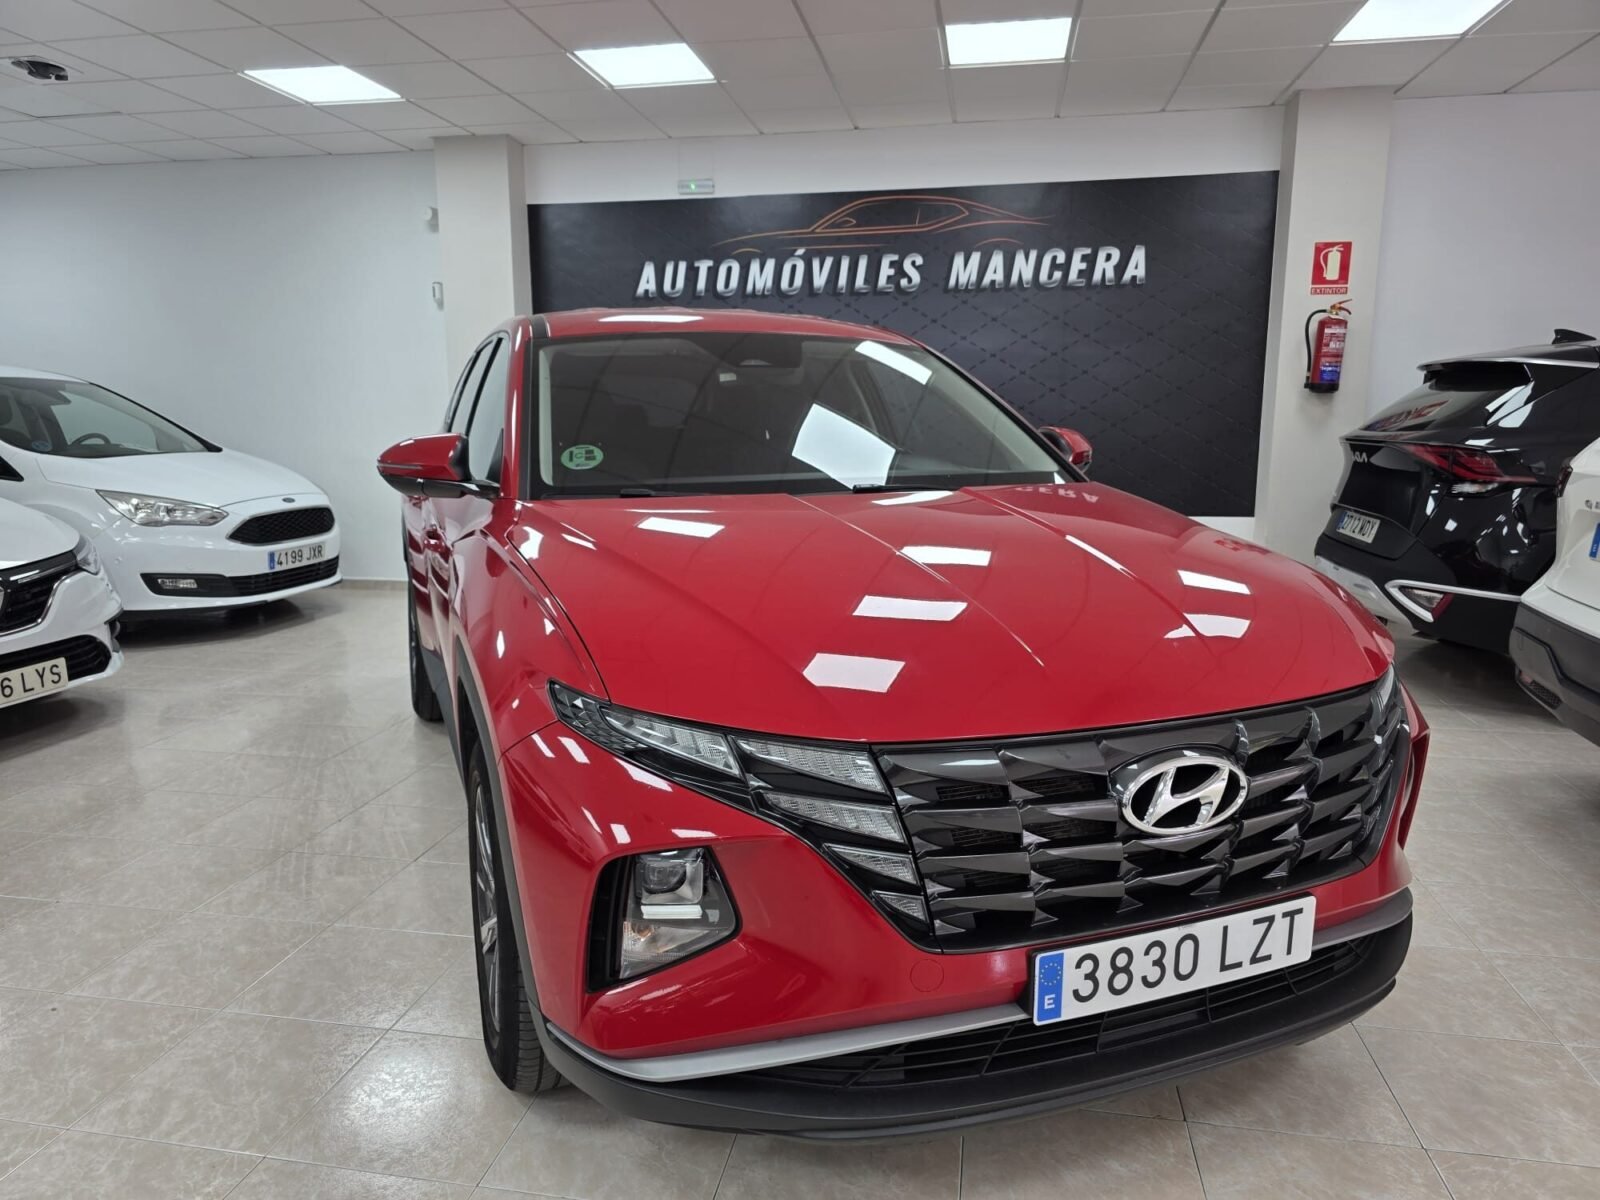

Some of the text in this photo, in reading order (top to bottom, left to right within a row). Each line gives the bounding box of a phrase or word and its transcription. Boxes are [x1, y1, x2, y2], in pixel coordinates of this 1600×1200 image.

[635, 245, 1146, 297] AUTOMÓVILES MANCERA
[277, 545, 323, 566] 4199 JXR
[21, 664, 61, 693] LYS
[1072, 907, 1304, 1003] 3830 LZT
[1044, 994, 1056, 1009] E
